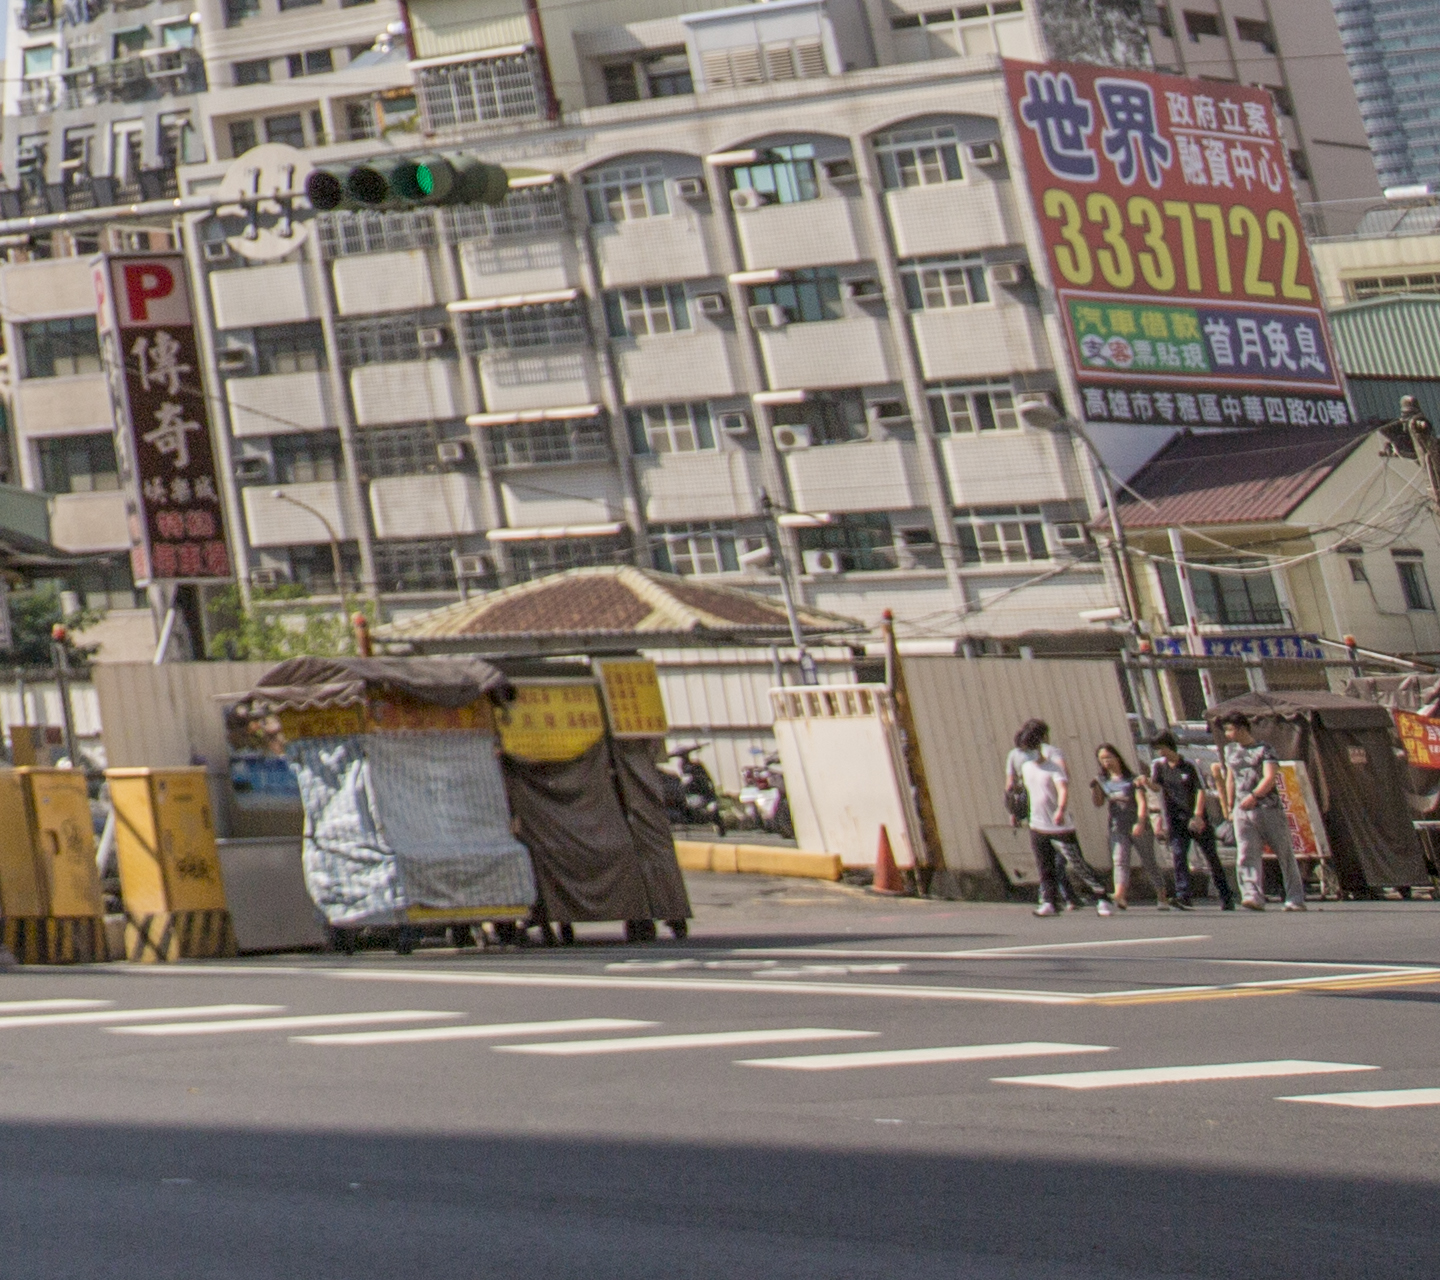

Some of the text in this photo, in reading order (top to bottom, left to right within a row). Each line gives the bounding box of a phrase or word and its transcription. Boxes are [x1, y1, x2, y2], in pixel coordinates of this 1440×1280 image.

[1019, 70, 1172, 189] 世界
[1164, 91, 1270, 137] 政府立案
[1174, 136, 1282, 193] 融資中心
[1042, 189, 1314, 301] 3337722
[123, 263, 174, 322] P
[1075, 305, 1202, 341] 汽車借款
[1203, 316, 1327, 375] 首月免息
[130, 329, 203, 469] 傳奇
[1083, 387, 1349, 427] 高雄市苓雅區中華四路20號
